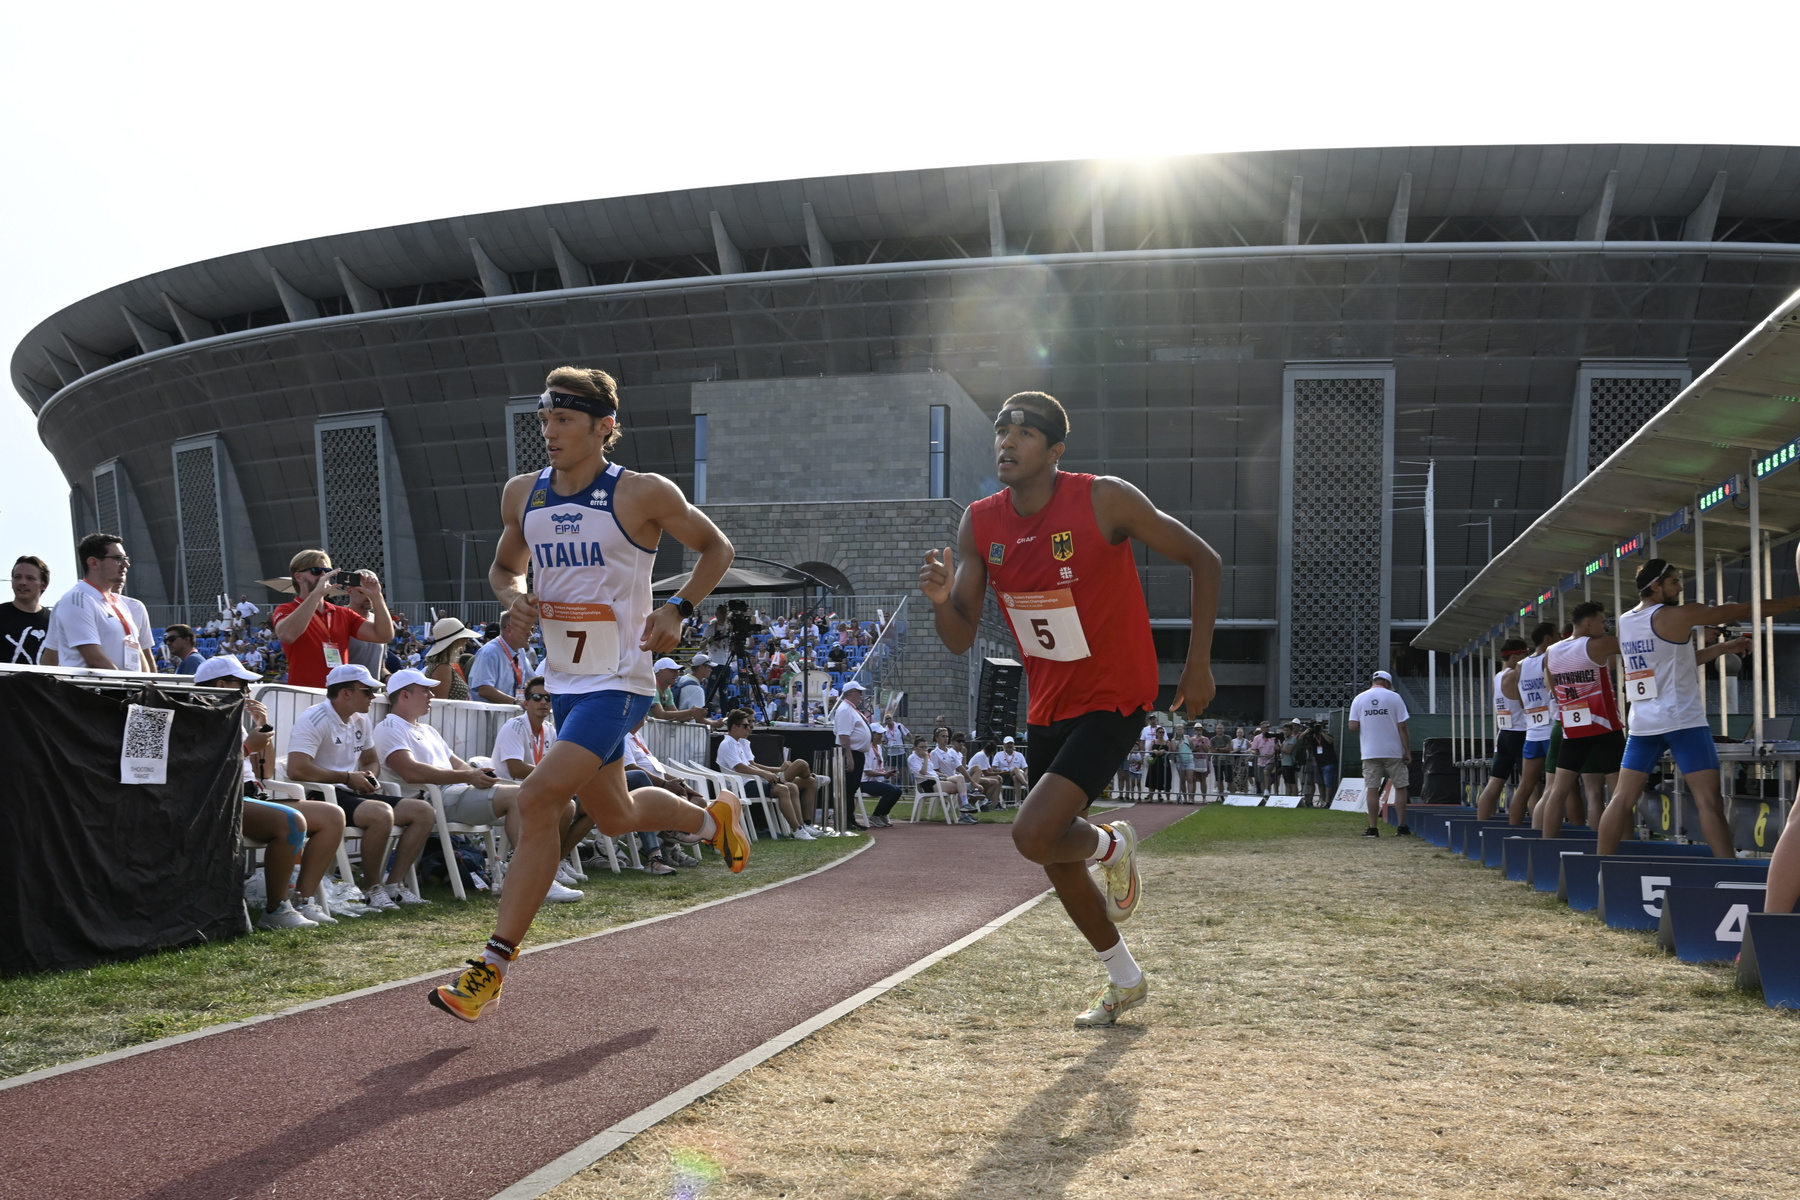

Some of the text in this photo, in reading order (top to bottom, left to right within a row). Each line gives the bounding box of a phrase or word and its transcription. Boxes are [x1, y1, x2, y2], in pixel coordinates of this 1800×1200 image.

[555, 524, 580, 533] FIPM
[534, 541, 605, 568] ITALIA
[1030, 619, 1056, 650] 5
[566, 630, 588, 664] 7
[1629, 655, 1648, 670] ITA
[1527, 691, 1543, 702] ITA
[1637, 681, 1646, 695] 6
[1364, 708, 1389, 717] JUDGE
[1531, 713, 1543, 724] 10
[1572, 711, 1581, 723] 8
[1660, 794, 1670, 831] 8
[1753, 802, 1770, 848] 6
[1640, 875, 1672, 918] 5
[1715, 903, 1750, 942] 4
